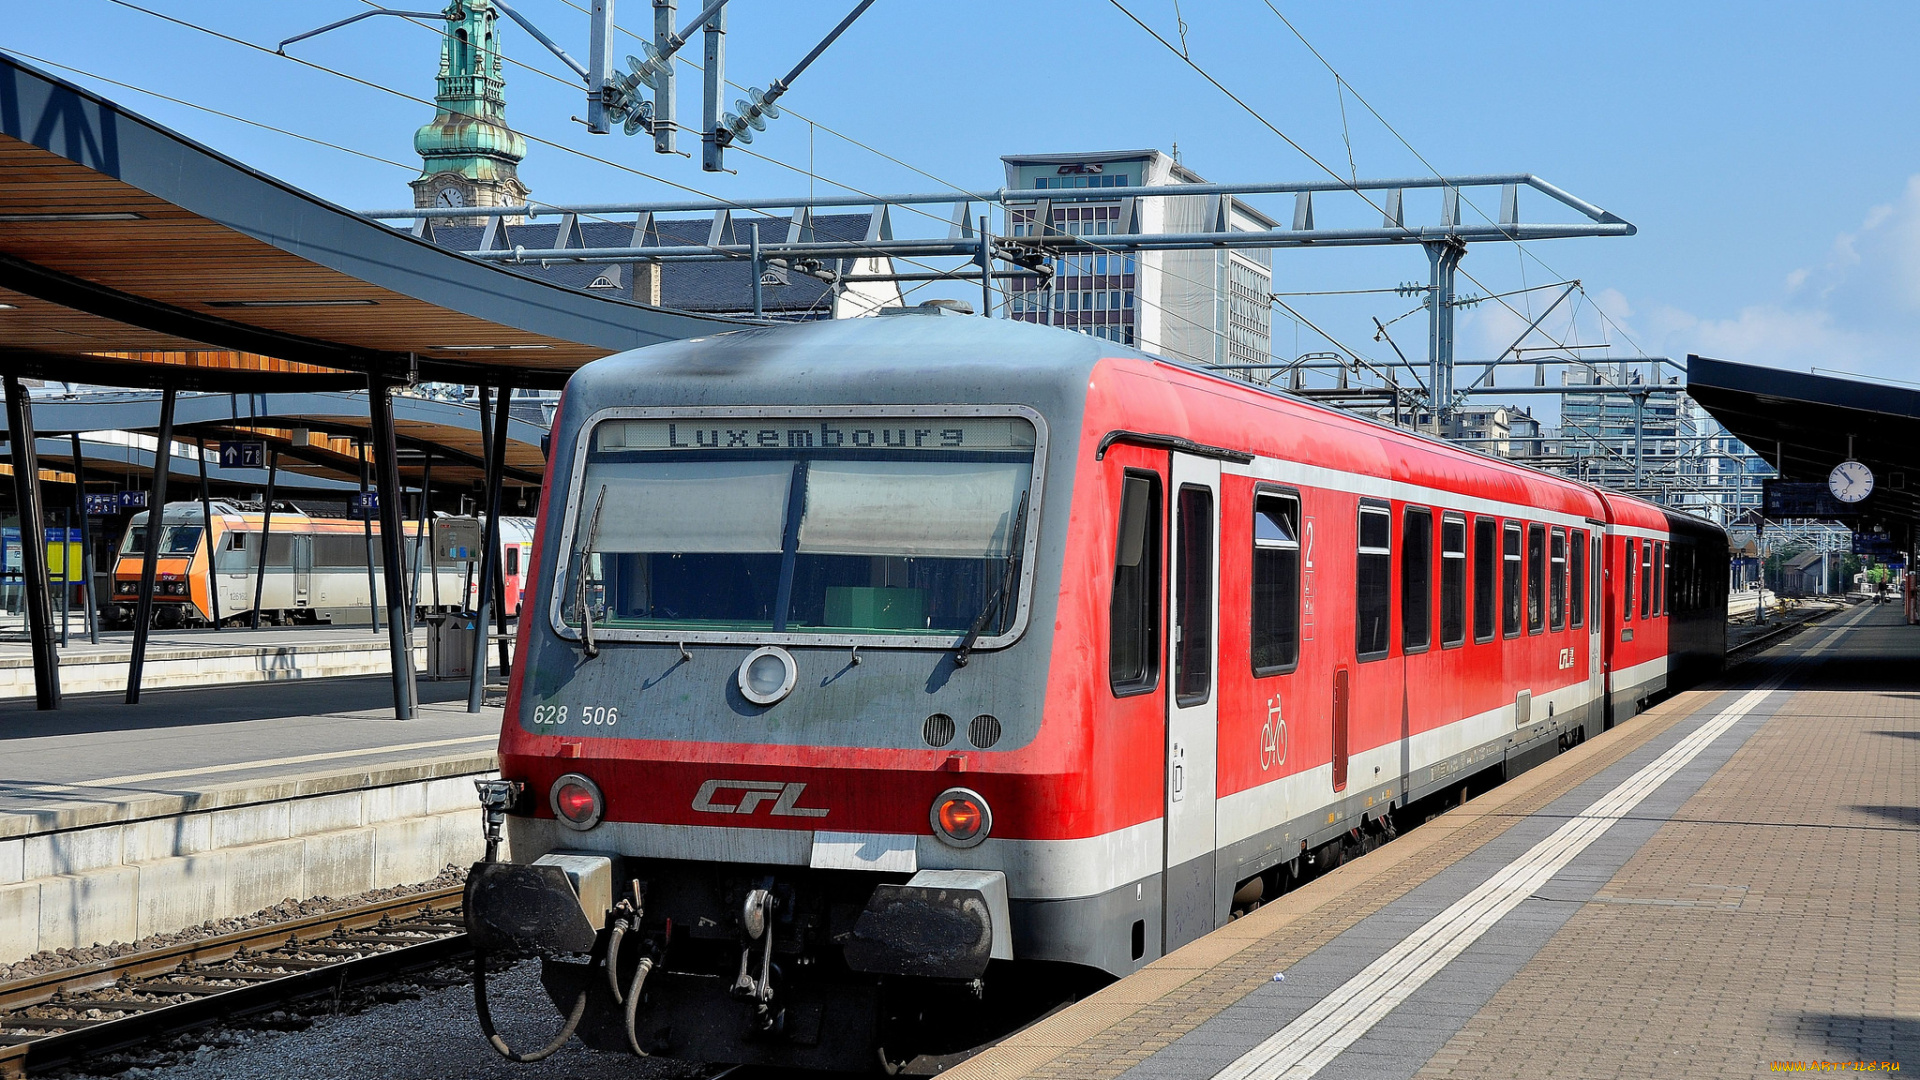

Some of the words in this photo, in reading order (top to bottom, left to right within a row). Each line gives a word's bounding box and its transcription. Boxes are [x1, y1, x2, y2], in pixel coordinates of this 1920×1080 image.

[669, 423, 963, 448] Luxembourg
[245, 450, 252, 463] 7
[362, 497, 368, 505] 5
[1306, 521, 1313, 568] 2
[533, 705, 568, 724] 628
[581, 706, 618, 726] 506
[691, 779, 830, 817] CFL
